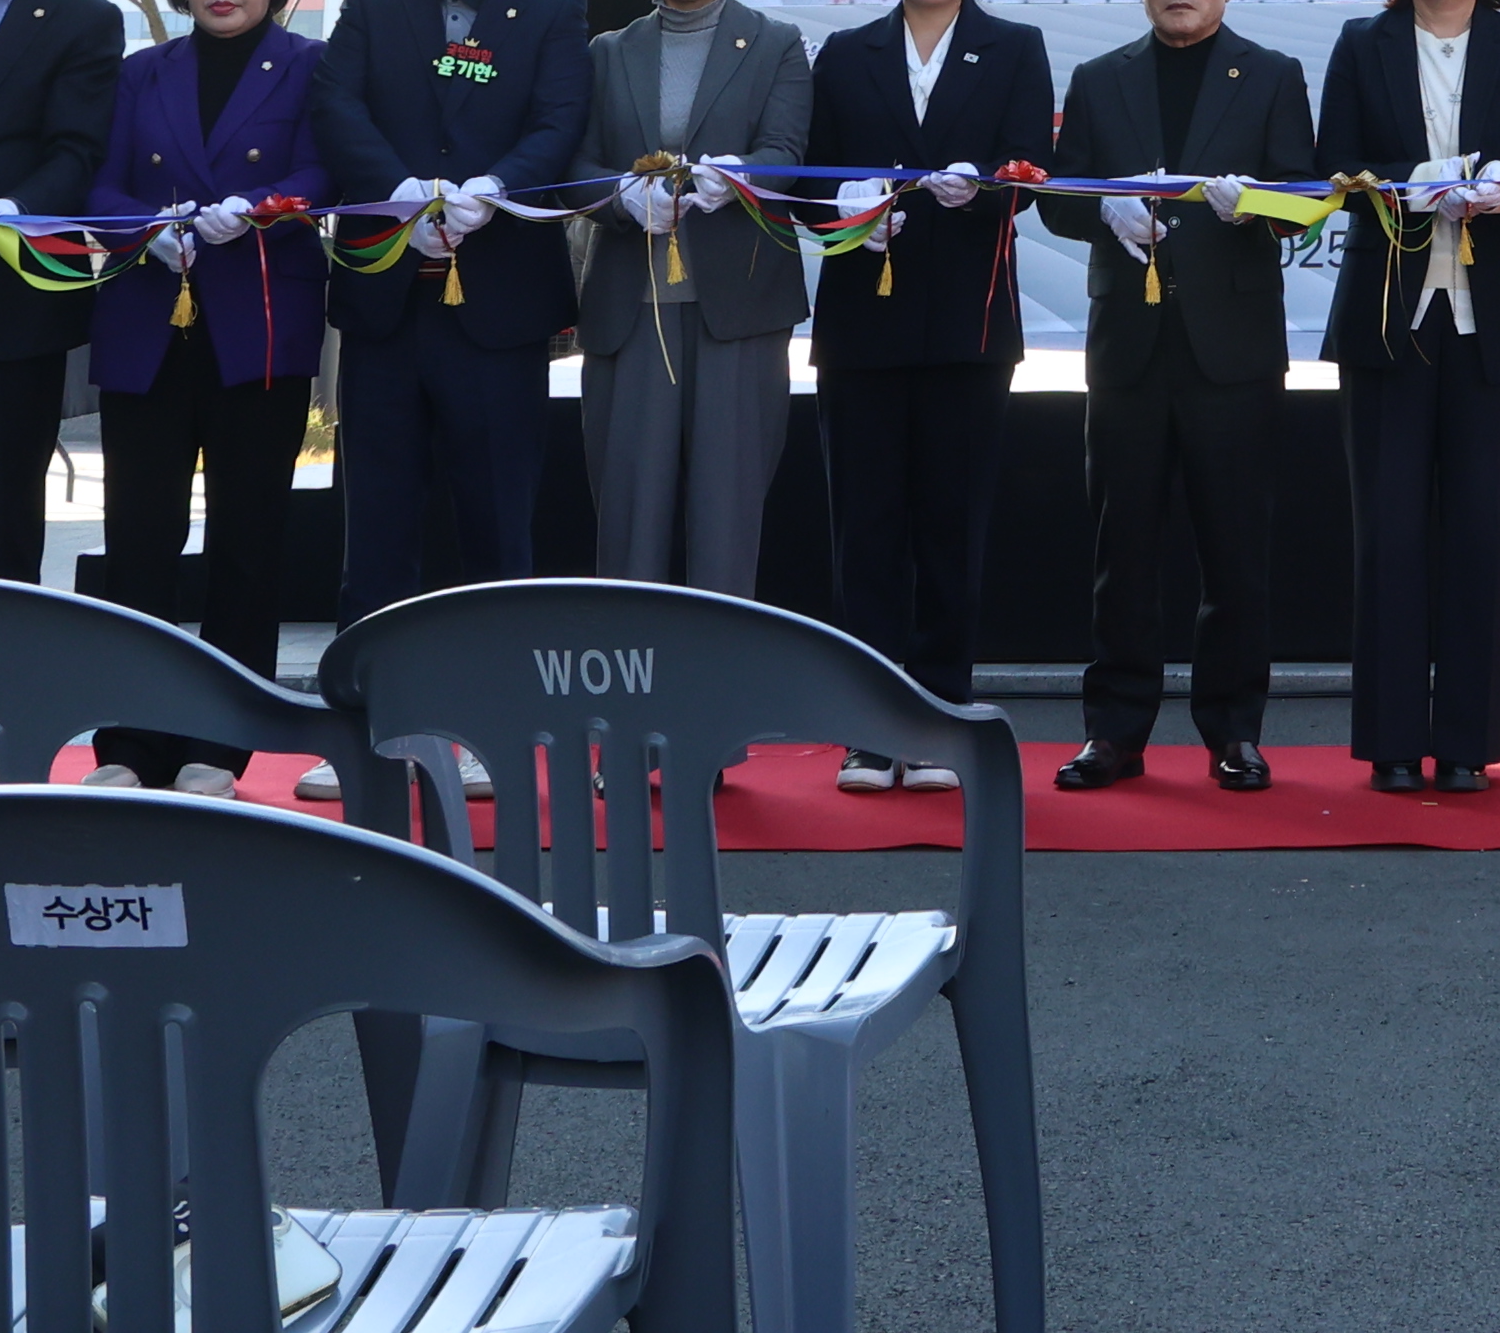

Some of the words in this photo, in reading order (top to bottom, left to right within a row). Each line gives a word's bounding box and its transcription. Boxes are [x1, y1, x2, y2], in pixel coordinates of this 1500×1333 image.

[437, 55, 493, 84] 윤기현
[532, 646, 656, 697] WOW
[40, 893, 153, 933] 수상자
